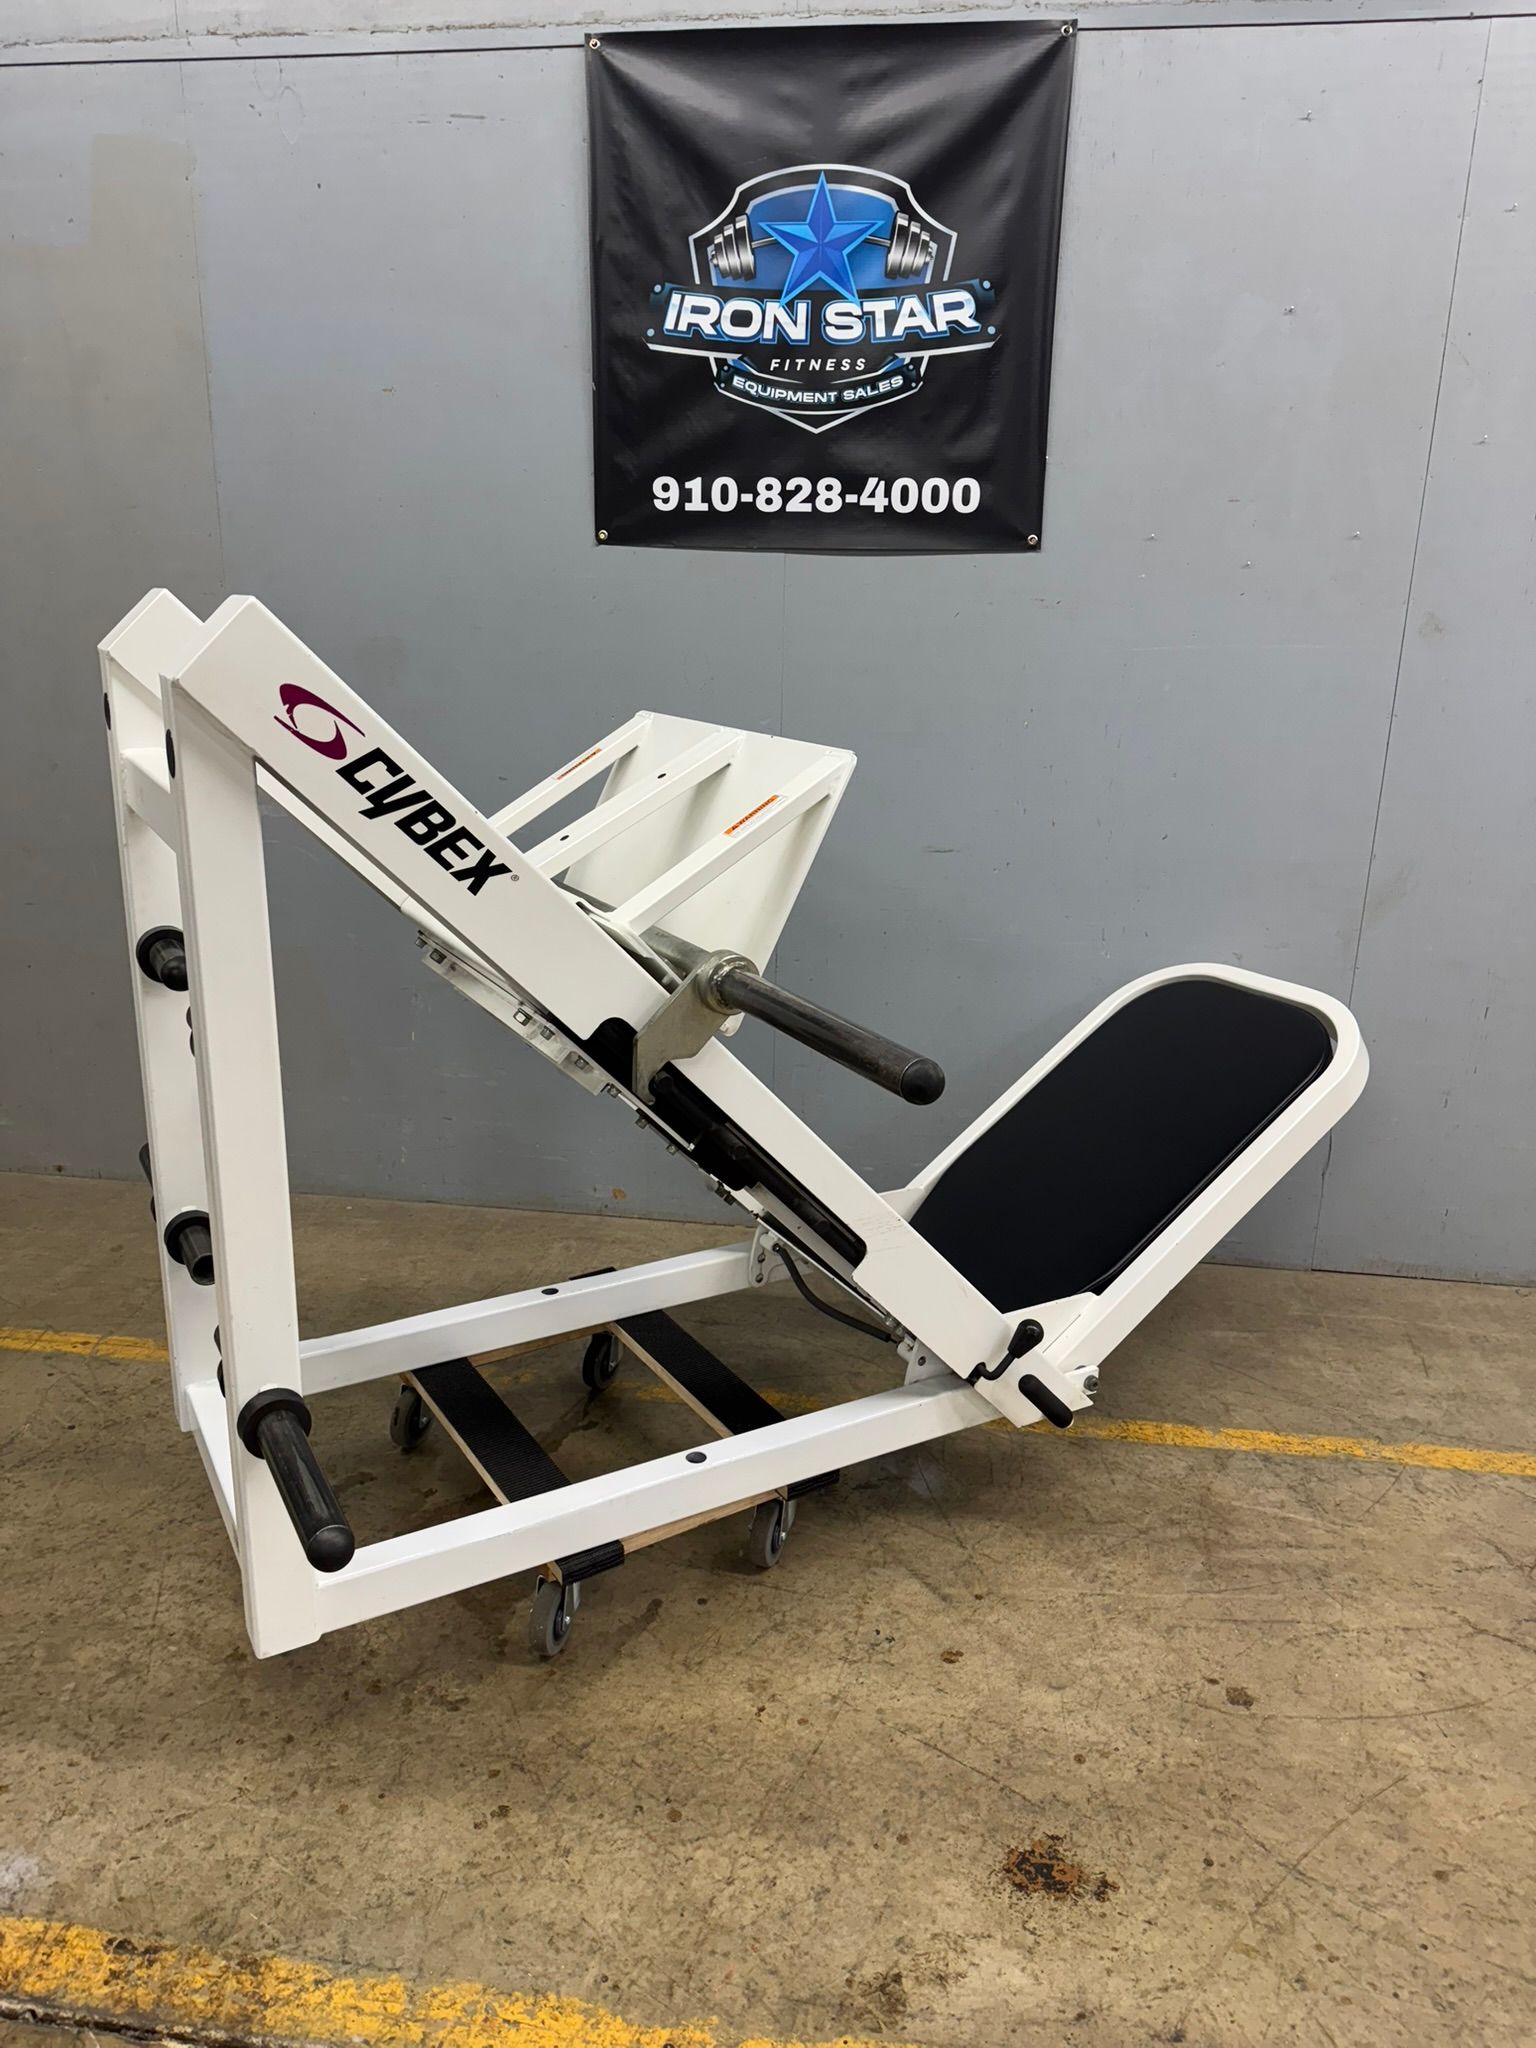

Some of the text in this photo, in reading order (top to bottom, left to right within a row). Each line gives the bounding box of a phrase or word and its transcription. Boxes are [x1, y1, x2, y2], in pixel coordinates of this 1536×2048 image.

[664, 290, 981, 344] IRON STAR
[770, 358, 866, 372] FITNESS
[732, 376, 903, 403] EQUIPMENT SALES
[652, 475, 981, 513] 910-828-4000
